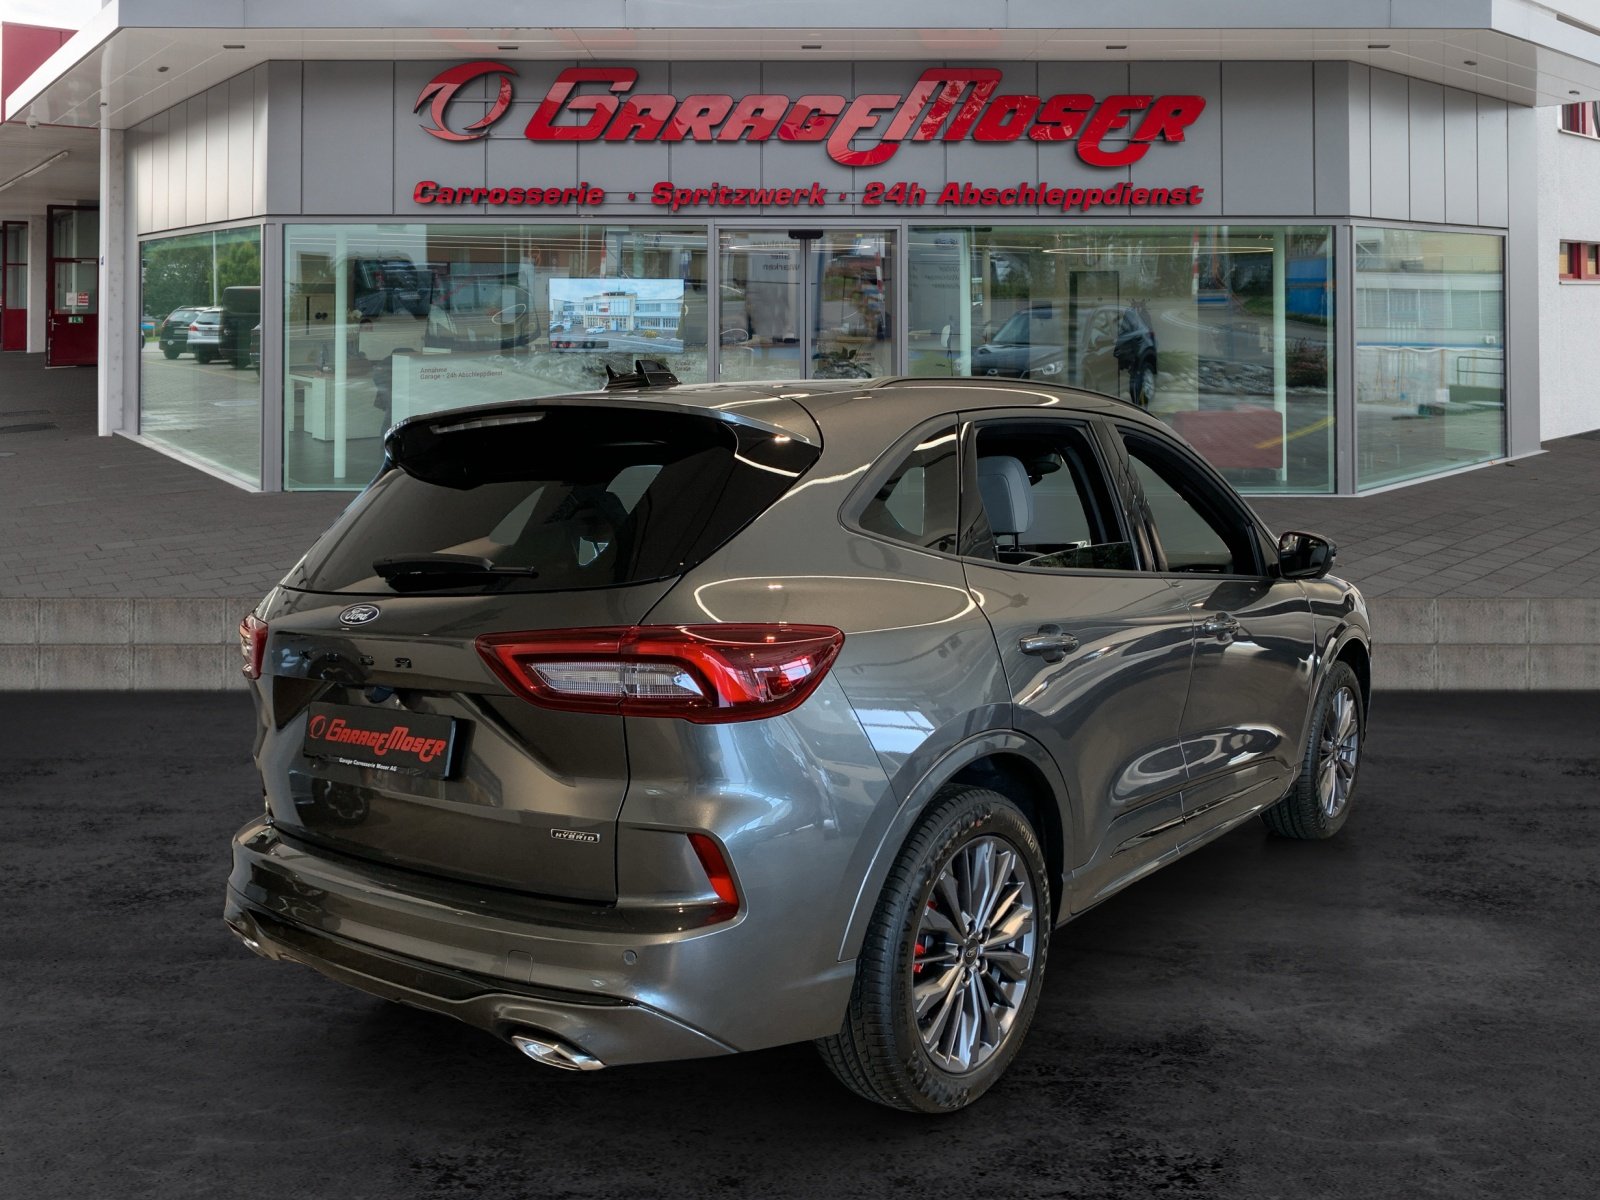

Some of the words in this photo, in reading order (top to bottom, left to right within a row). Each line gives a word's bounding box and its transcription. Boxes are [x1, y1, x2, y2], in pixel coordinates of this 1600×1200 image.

[413, 181, 605, 206] Carrosserie
[651, 181, 826, 211] Spritzwerk
[862, 181, 927, 206] 24h
[936, 181, 1204, 212] Abschleppdienst
[555, 832, 595, 841] HYBRID
